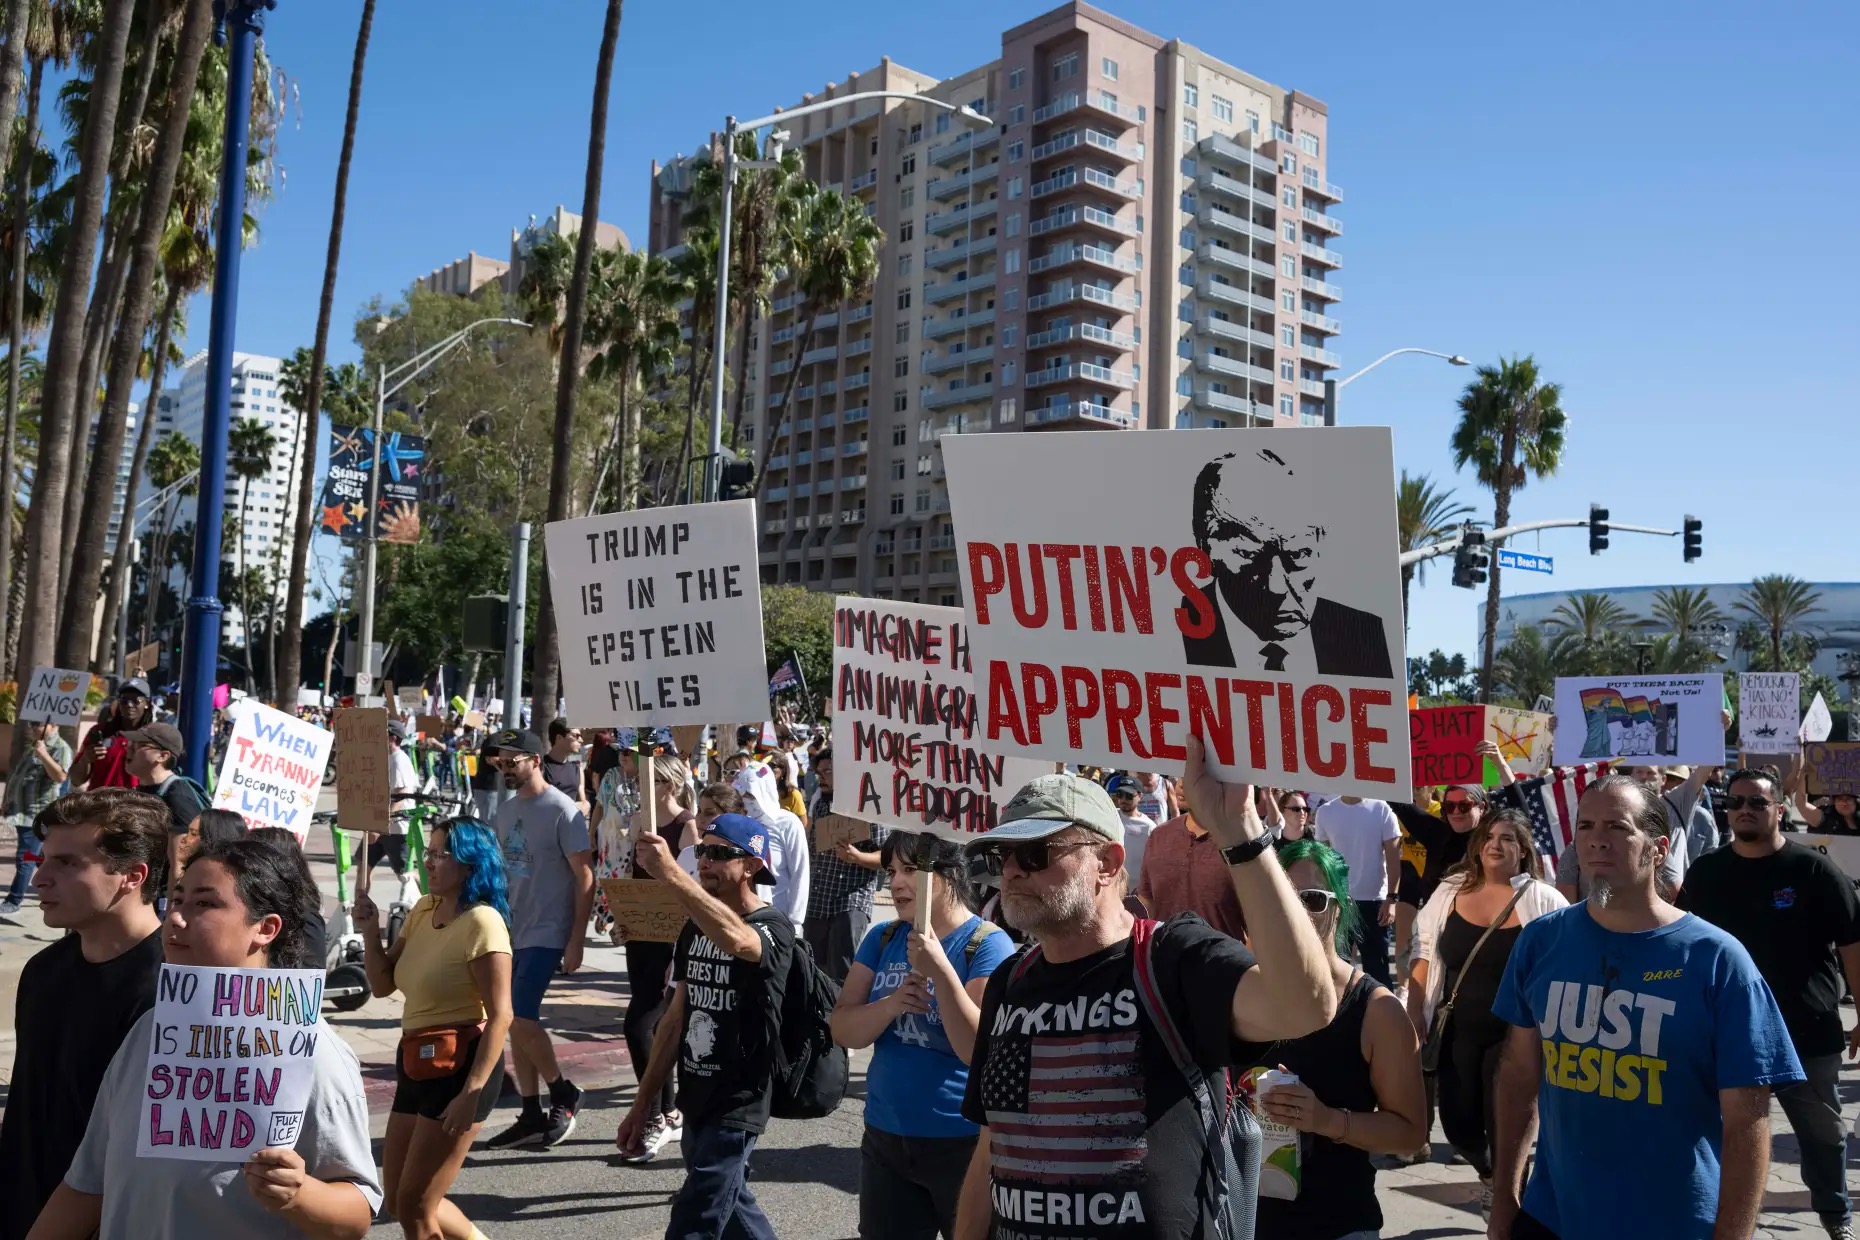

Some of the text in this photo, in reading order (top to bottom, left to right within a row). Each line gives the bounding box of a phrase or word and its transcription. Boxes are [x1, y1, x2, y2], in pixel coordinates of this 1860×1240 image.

[329, 465, 368, 482] Stars
[586, 522, 690, 564] TRUMP
[1499, 553, 1552, 571] Long Beach Blvd
[581, 565, 743, 615] IS IN THE
[967, 542, 1216, 639] PUTIN'S
[587, 621, 716, 665] EPSTEIN
[835, 608, 942, 665] IMAGINE
[608, 674, 700, 712] FILES
[838, 663, 980, 741] AN IMMIGRA
[1741, 675, 1797, 689] DEMOCRACY
[1748, 690, 1788, 703] HAS NO
[987, 660, 1396, 784] APPRENTICE
[1432, 711, 1476, 738] HAT
[1749, 704, 1787, 720] KINGS
[253, 712, 318, 760] WHEN
[853, 721, 1005, 792] MORE THAN
[236, 736, 320, 789] TYRANNY
[1412, 753, 1474, 783] TRED
[232, 767, 296, 804] becomes
[858, 772, 881, 815] A
[241, 790, 298, 826] LAW
[687, 960, 731, 985] ERES UN
[888, 962, 908, 971] LOS
[160, 968, 322, 1026] NO HUMAN
[154, 1022, 318, 1059] IS ILLEGAL ON
[1539, 981, 1676, 1058] JUST
[147, 1064, 283, 1106] STOLEN
[1542, 1040, 1668, 1105] RESIST
[150, 1104, 256, 1149] LAND
[990, 1184, 1146, 1226] AMERICA
